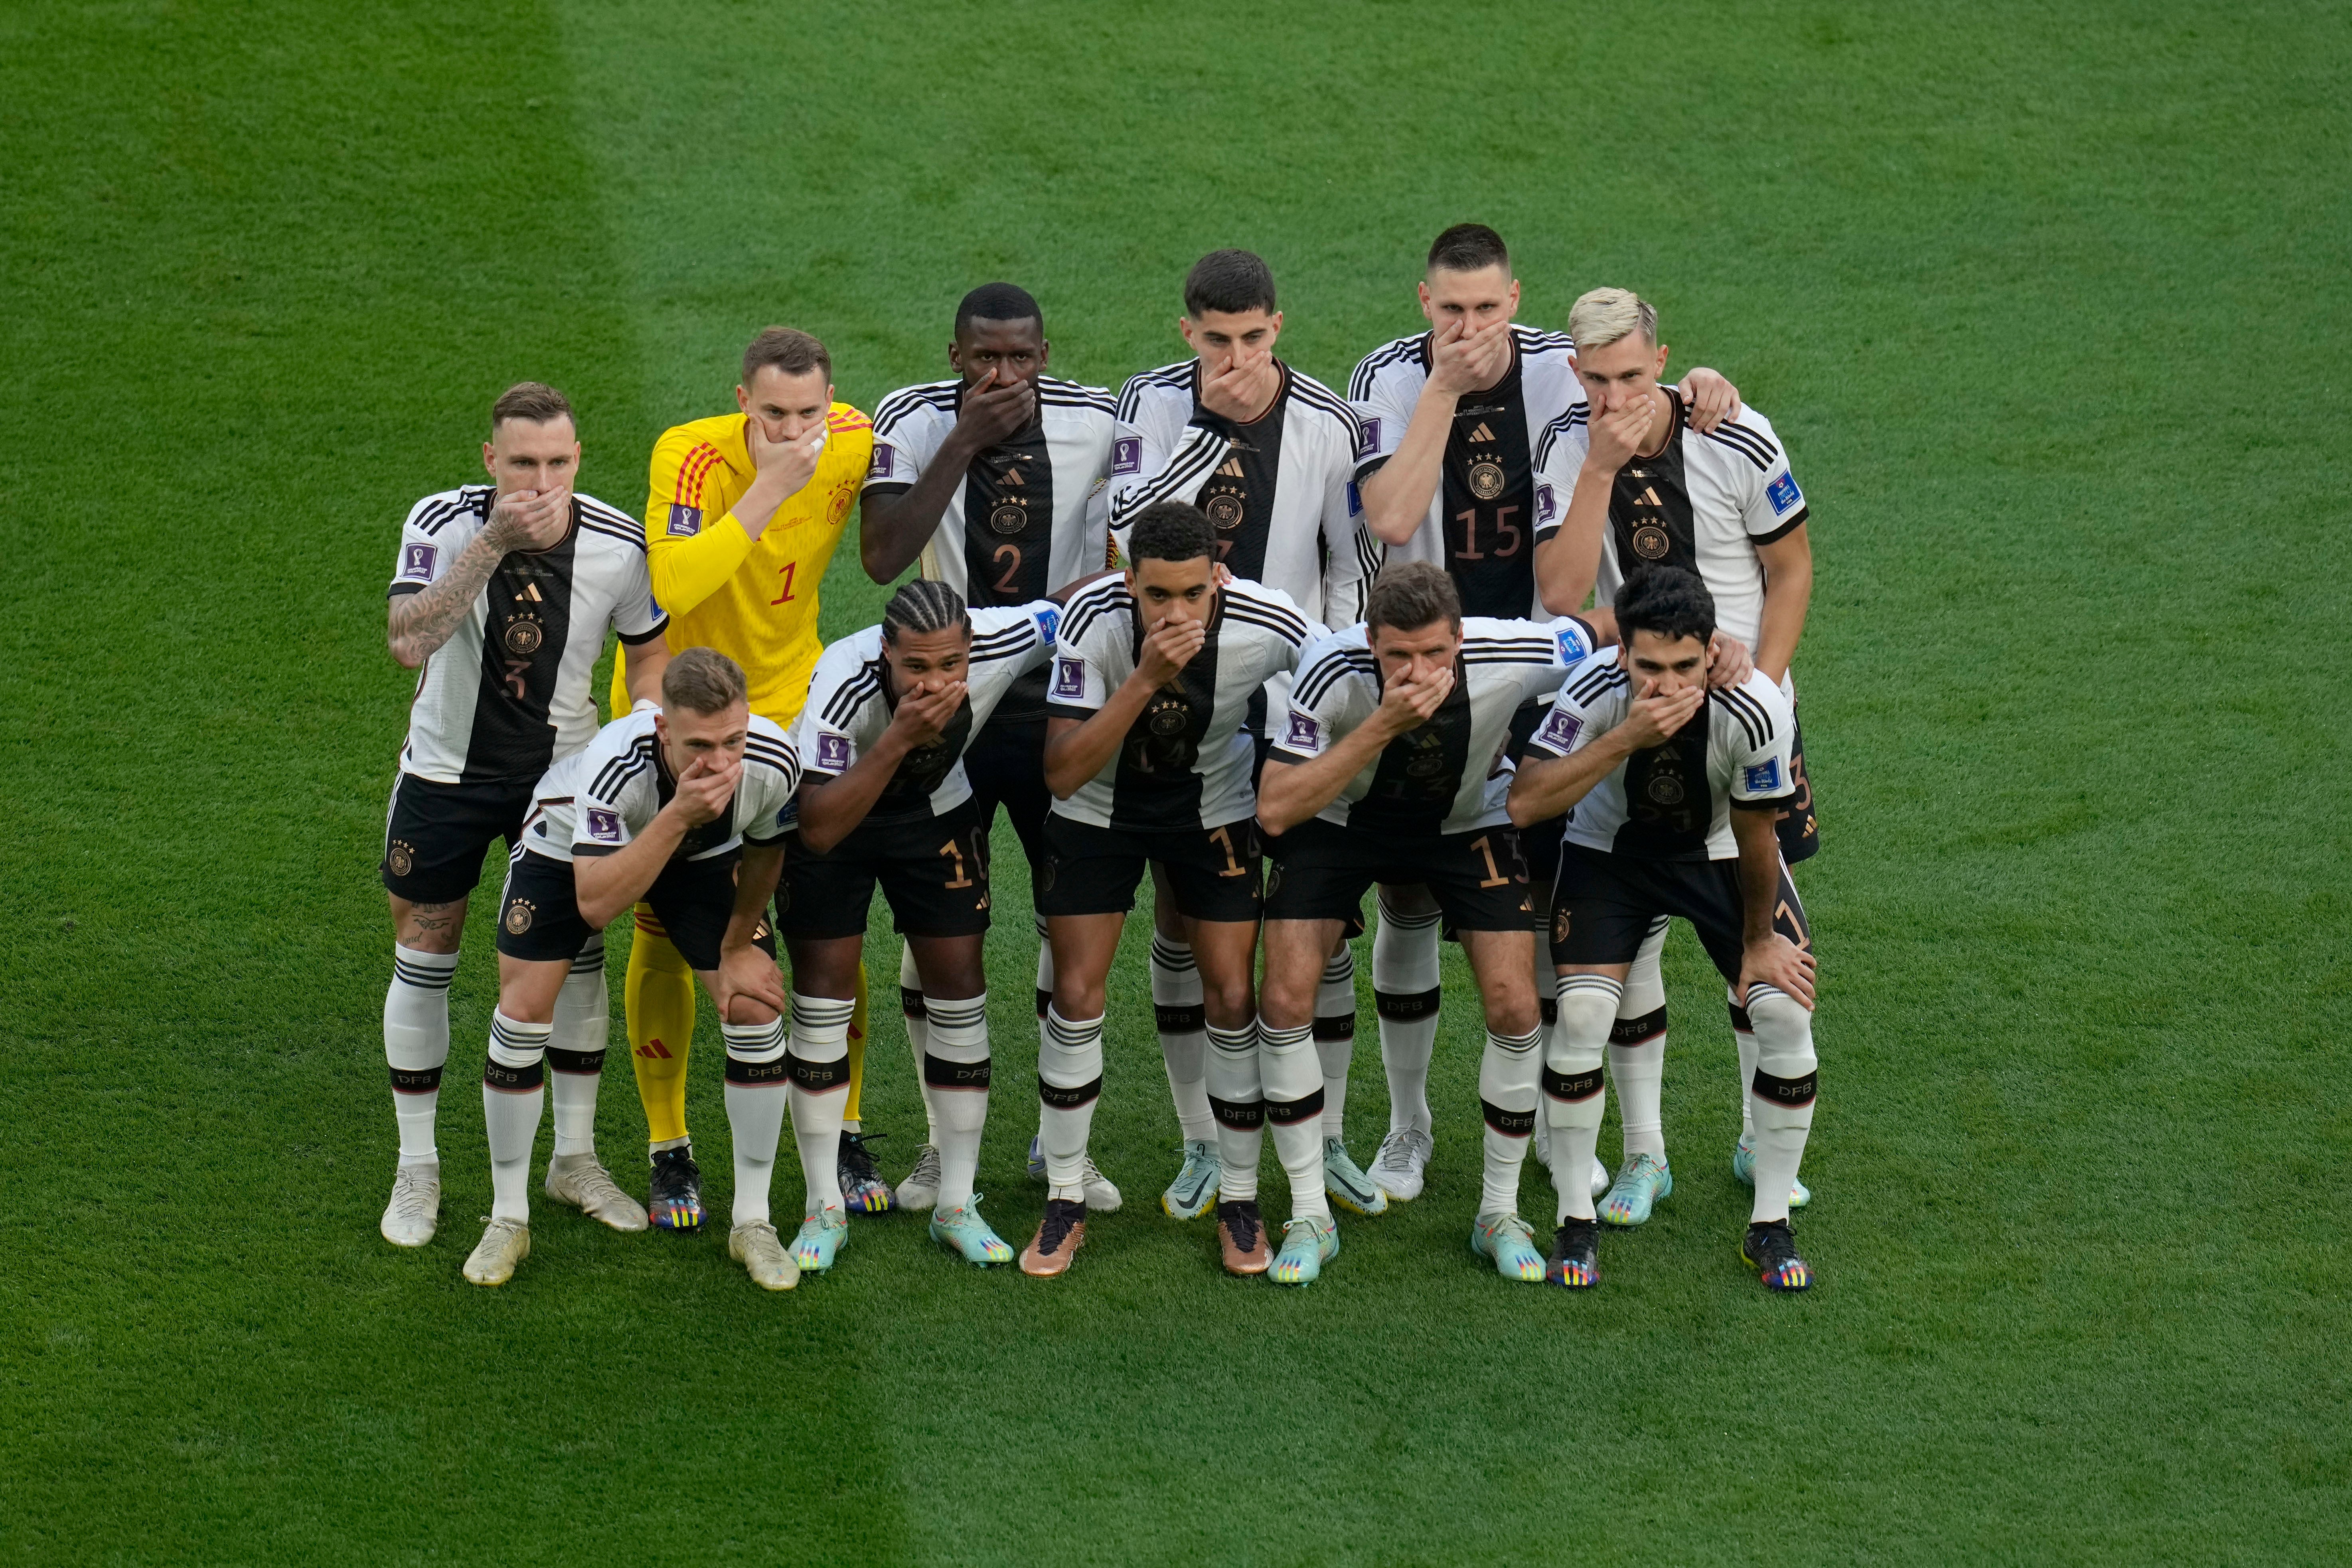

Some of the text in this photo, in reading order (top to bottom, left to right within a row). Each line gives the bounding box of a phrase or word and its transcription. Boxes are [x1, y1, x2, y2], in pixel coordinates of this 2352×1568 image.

[1455, 505, 1521, 559] 15
[992, 544, 1021, 593] 2
[770, 561, 796, 606] 1
[1471, 833, 1530, 889] 13
[1387, 1001, 1423, 1012] DFB
[1158, 1013, 1191, 1023] DFB
[1613, 1022, 1648, 1037] DFB
[487, 1064, 518, 1082] DFB
[748, 1065, 782, 1077] DFB
[798, 1067, 833, 1082] DFB
[957, 1067, 990, 1079] DFB
[398, 1075, 431, 1084] DFB
[1561, 1078, 1594, 1092] DFB
[1043, 1088, 1079, 1102] DFB
[1778, 1082, 1812, 1098] DFB
[1224, 1108, 1257, 1121] DFB
[1501, 1116, 1533, 1128] DFB
